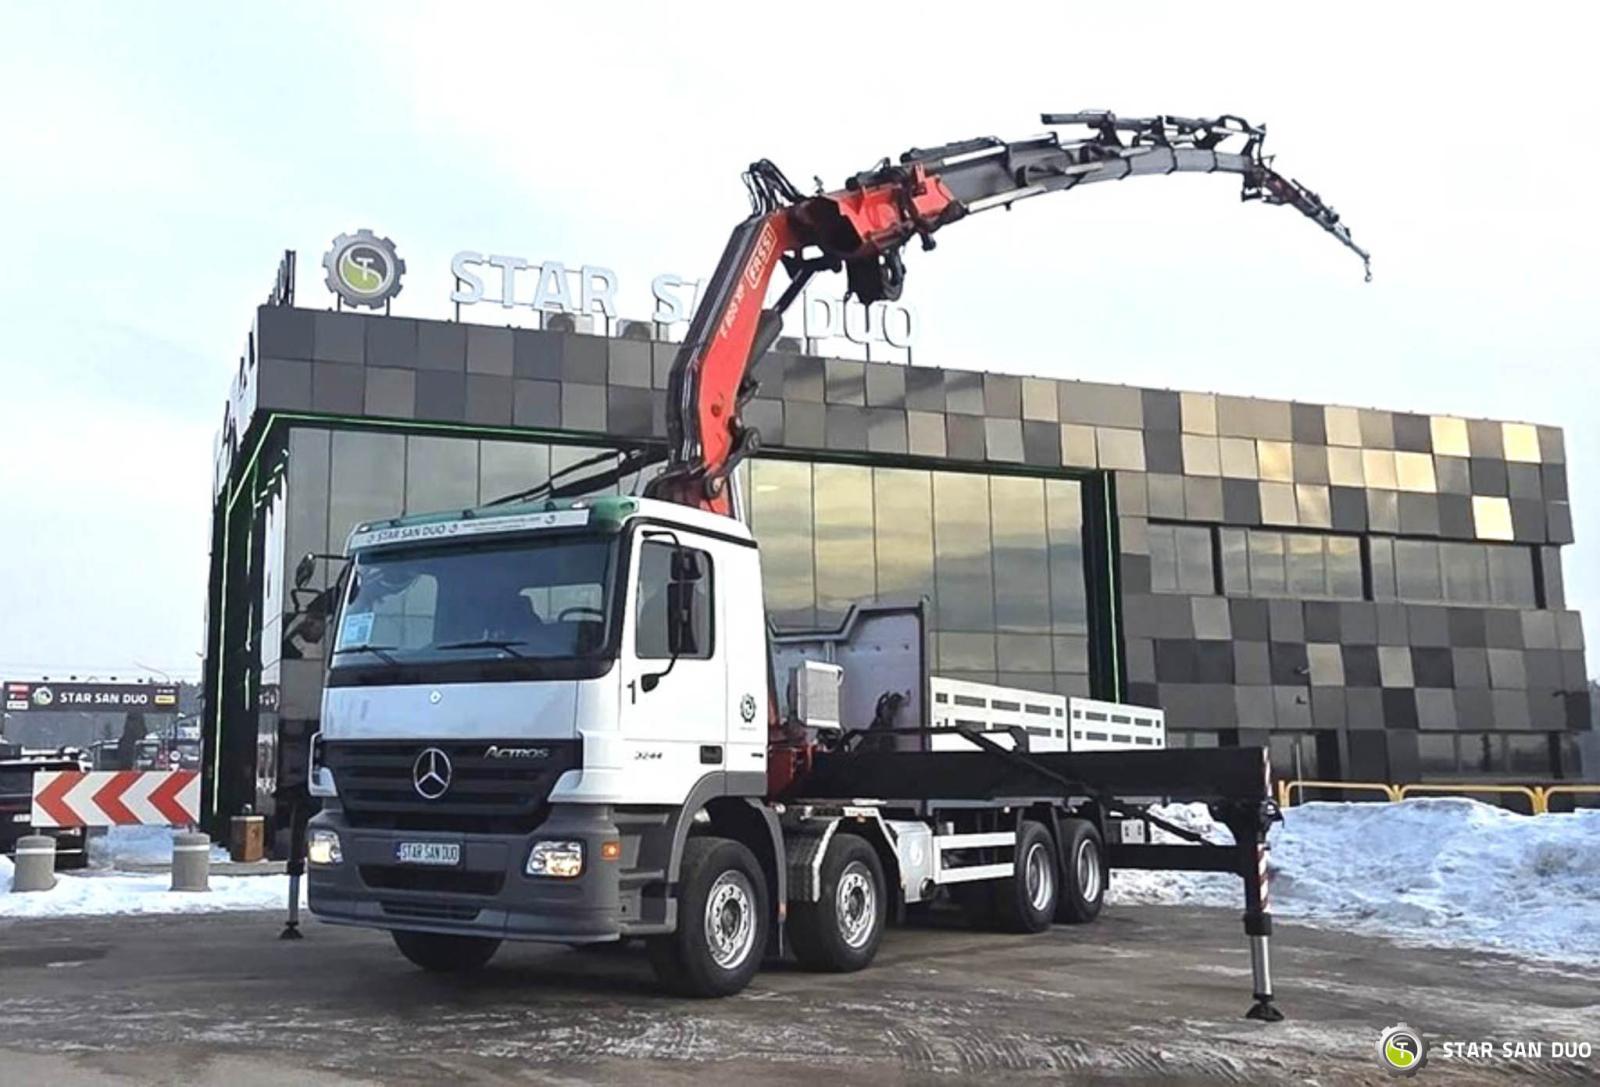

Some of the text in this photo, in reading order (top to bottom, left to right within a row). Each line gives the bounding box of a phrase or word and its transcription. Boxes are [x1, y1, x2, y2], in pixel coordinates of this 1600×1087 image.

[450, 250, 618, 319] STAR
[803, 290, 921, 349] DUO
[377, 523, 446, 543] STAR SAN DUO
[60, 691, 92, 704] STAR
[94, 692, 120, 704] SAN
[122, 693, 148, 705] DUO
[402, 843, 458, 861] STAR SAN DUO
